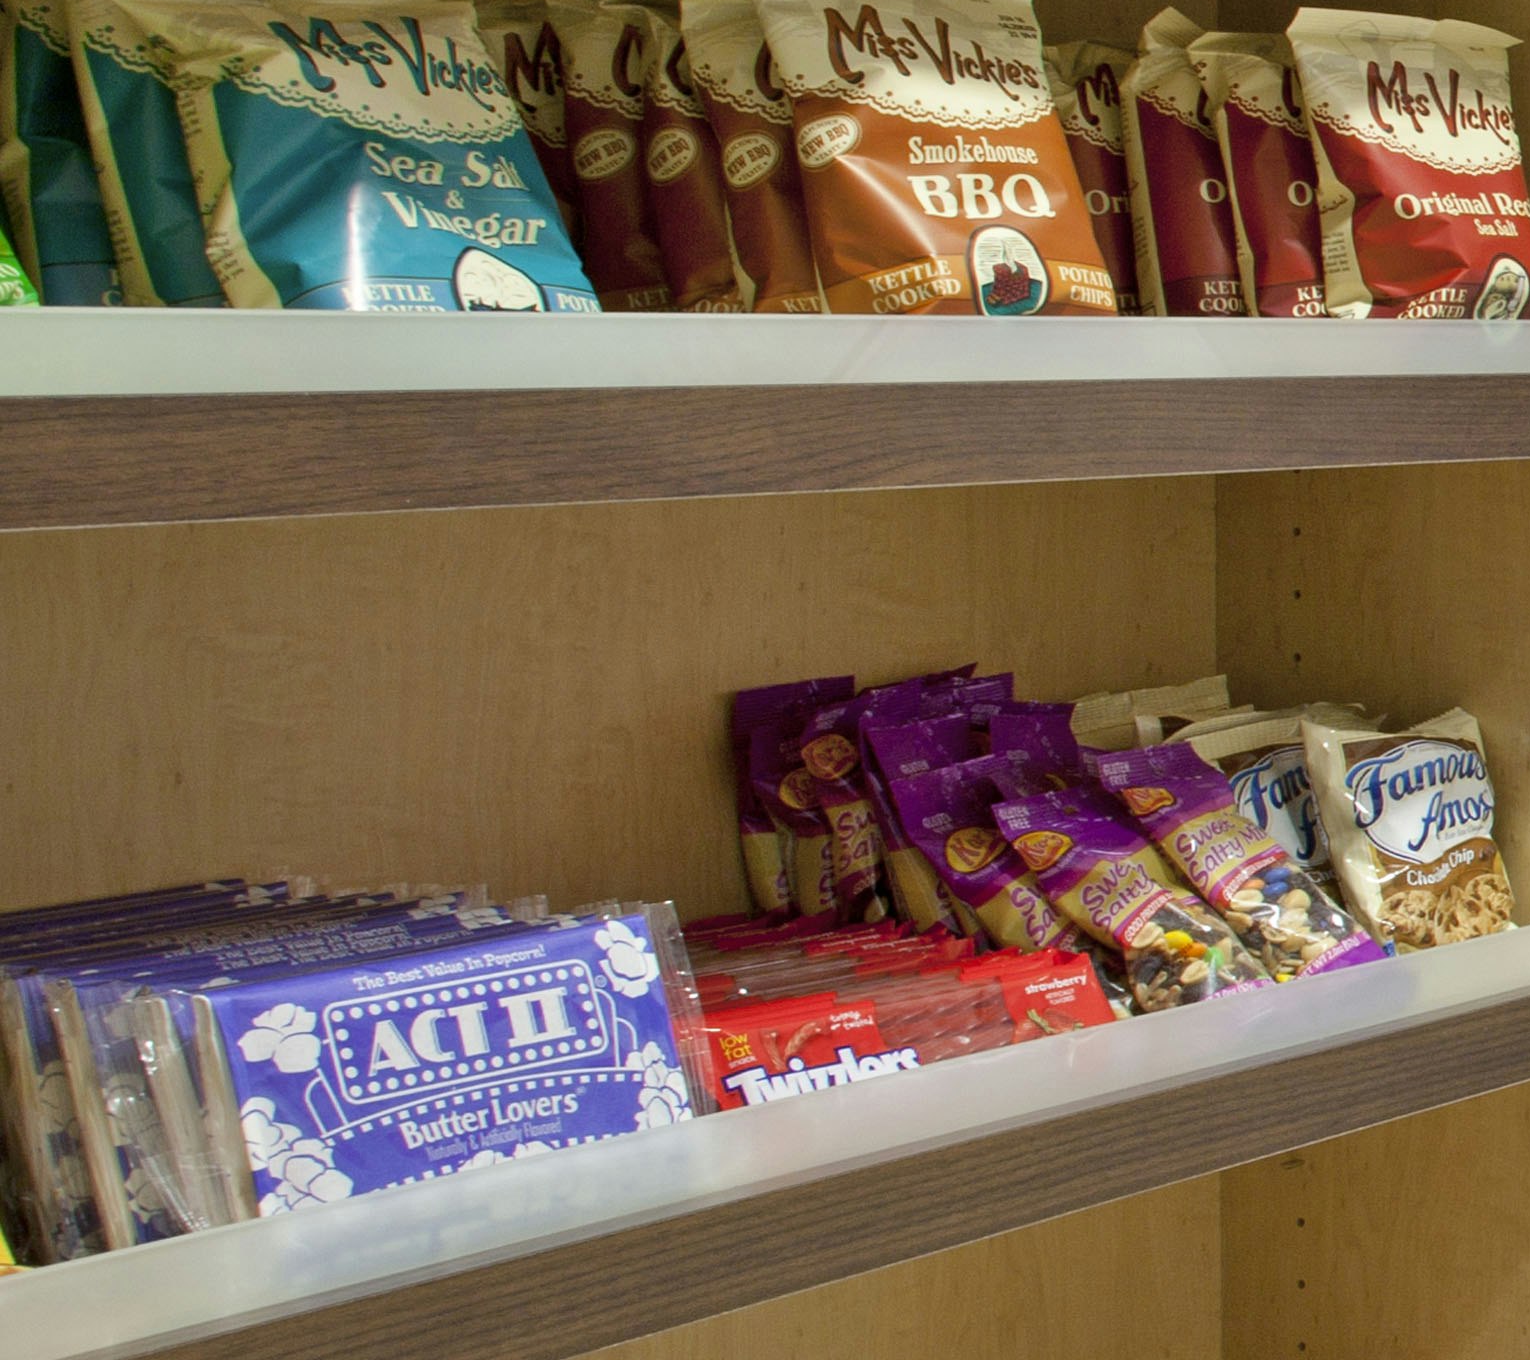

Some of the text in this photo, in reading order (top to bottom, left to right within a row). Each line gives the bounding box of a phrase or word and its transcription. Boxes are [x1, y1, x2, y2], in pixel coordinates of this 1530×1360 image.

[908, 15, 1039, 91] Vickie's
[825, 123, 849, 144] BBQ
[909, 136, 1039, 166] Smokehouse
[365, 141, 445, 188] Sea
[906, 174, 1056, 221] BBQ
[1394, 191, 1490, 221] Original
[381, 191, 548, 248] Vinegar
[1475, 217, 1519, 237] Sea Salt
[869, 260, 952, 295] KETTLE
[873, 279, 962, 314] COOKED
[1070, 285, 1113, 307] CHIPS
[1344, 750, 1487, 829] Famous
[1407, 791, 1494, 852] Amos
[1187, 837, 1245, 889] Salty
[1448, 848, 1475, 867] Chip
[1091, 860, 1156, 933] Salty
[352, 943, 547, 993] The Best Value In Popcorn!
[1024, 973, 1087, 995] strawberry
[367, 986, 577, 1078] ACT II
[718, 1033, 749, 1052] low
[722, 1044, 753, 1062] fat
[400, 1090, 580, 1151] Butter Lovers
